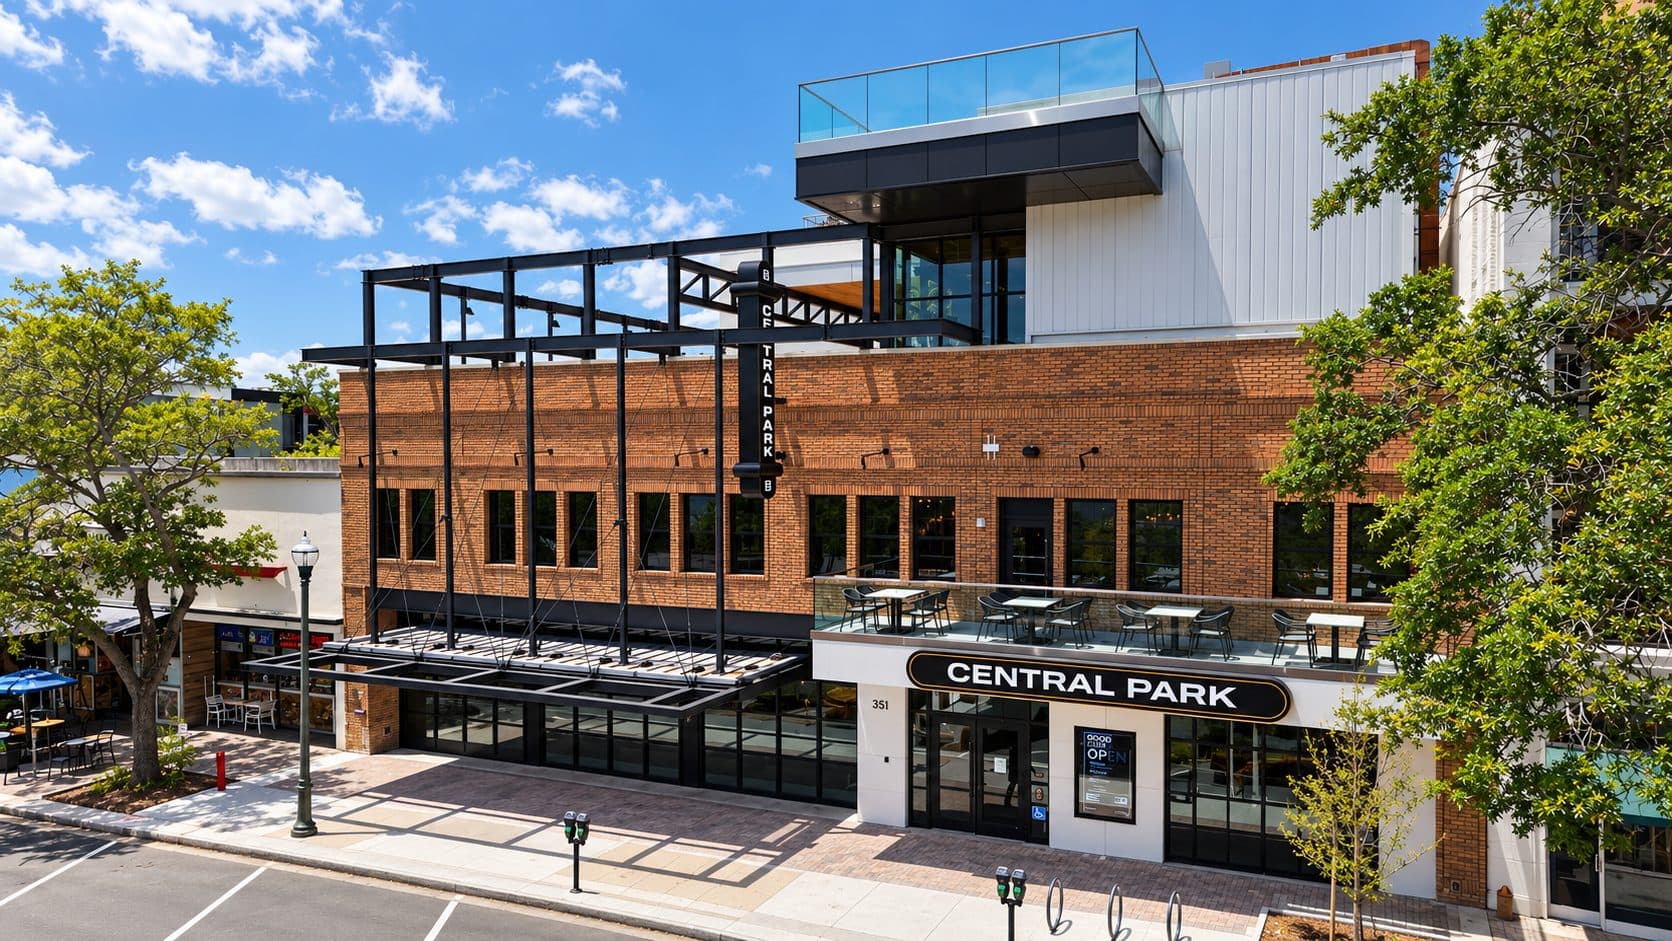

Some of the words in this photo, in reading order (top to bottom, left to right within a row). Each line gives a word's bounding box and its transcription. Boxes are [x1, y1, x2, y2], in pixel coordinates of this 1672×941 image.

[762, 304, 773, 398] CETRAL
[763, 405, 773, 457] PARK
[872, 699, 889, 710] 351
[947, 662, 1115, 697] CENTRAL
[1127, 678, 1237, 709] PARK
[1087, 748, 1127, 763] OPEN
